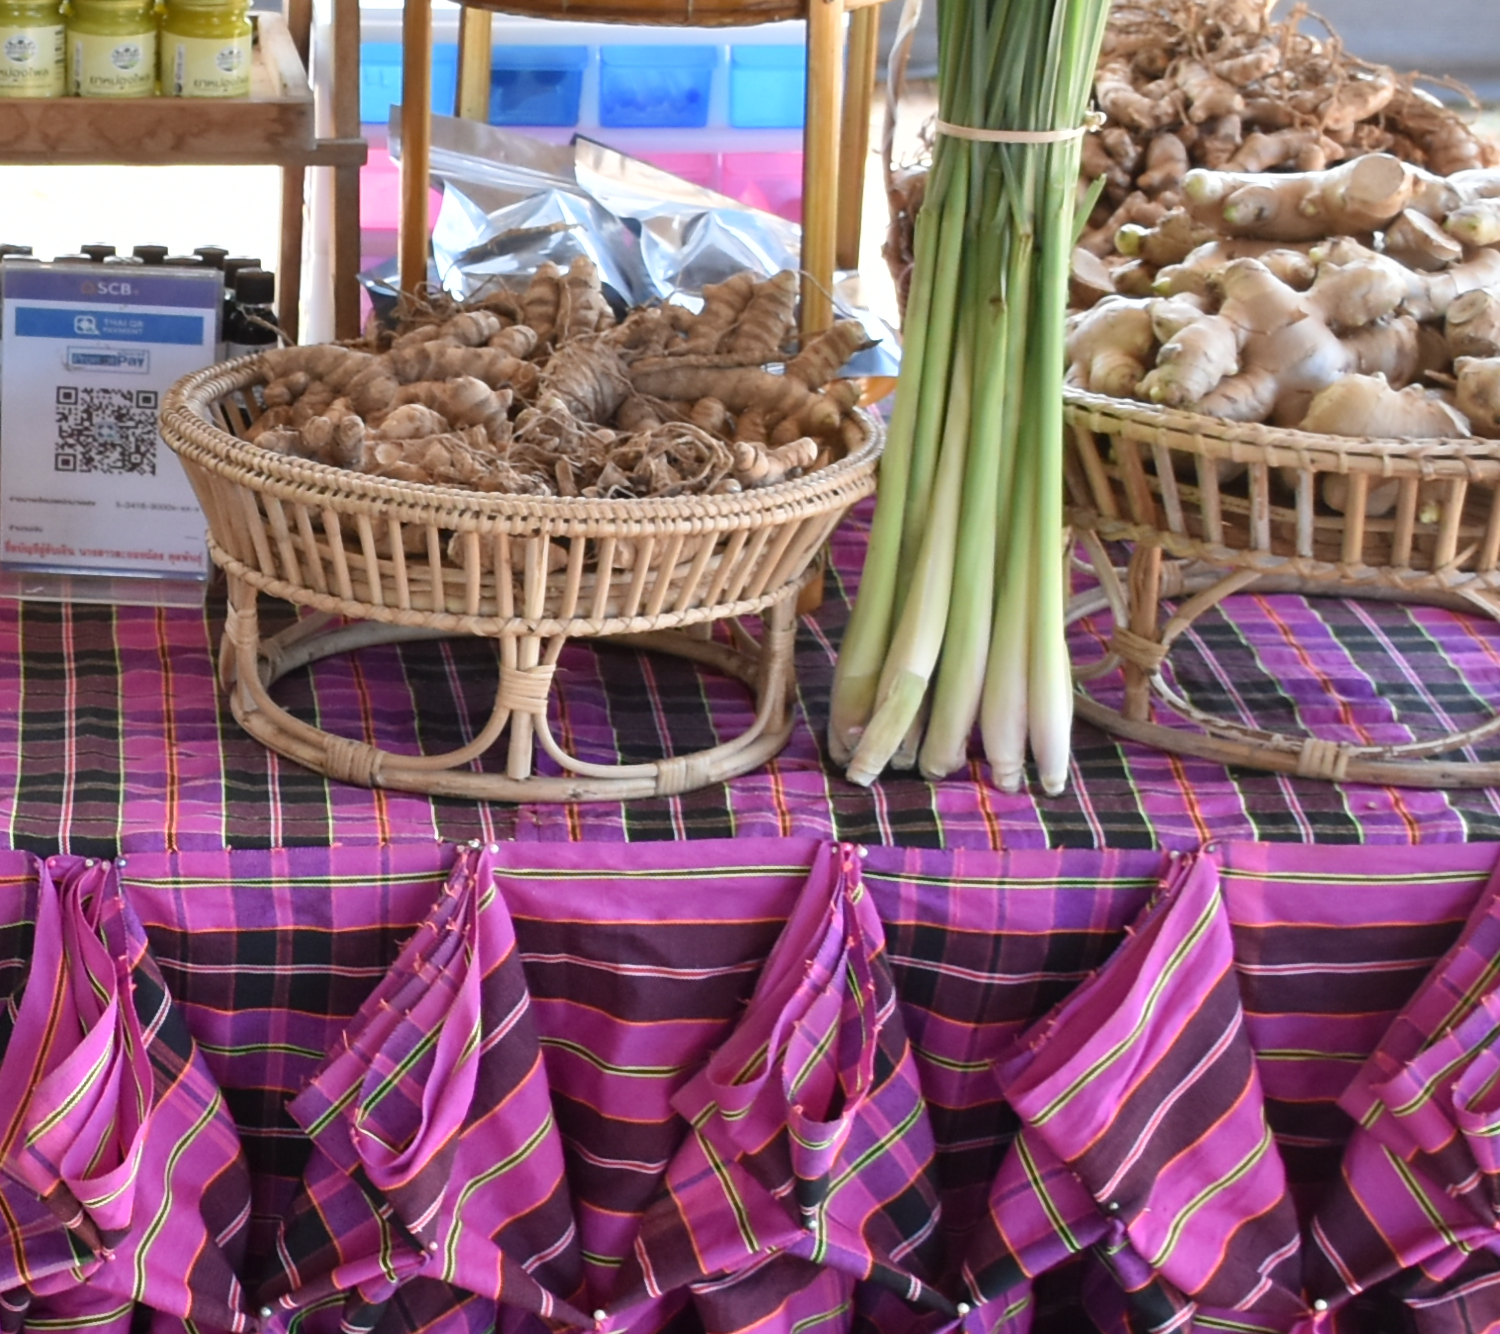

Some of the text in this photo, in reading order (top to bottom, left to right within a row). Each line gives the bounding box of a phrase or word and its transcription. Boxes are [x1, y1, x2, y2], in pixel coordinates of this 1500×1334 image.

[98, 282, 131, 295] SCB
[103, 318, 144, 328] THAI QR
